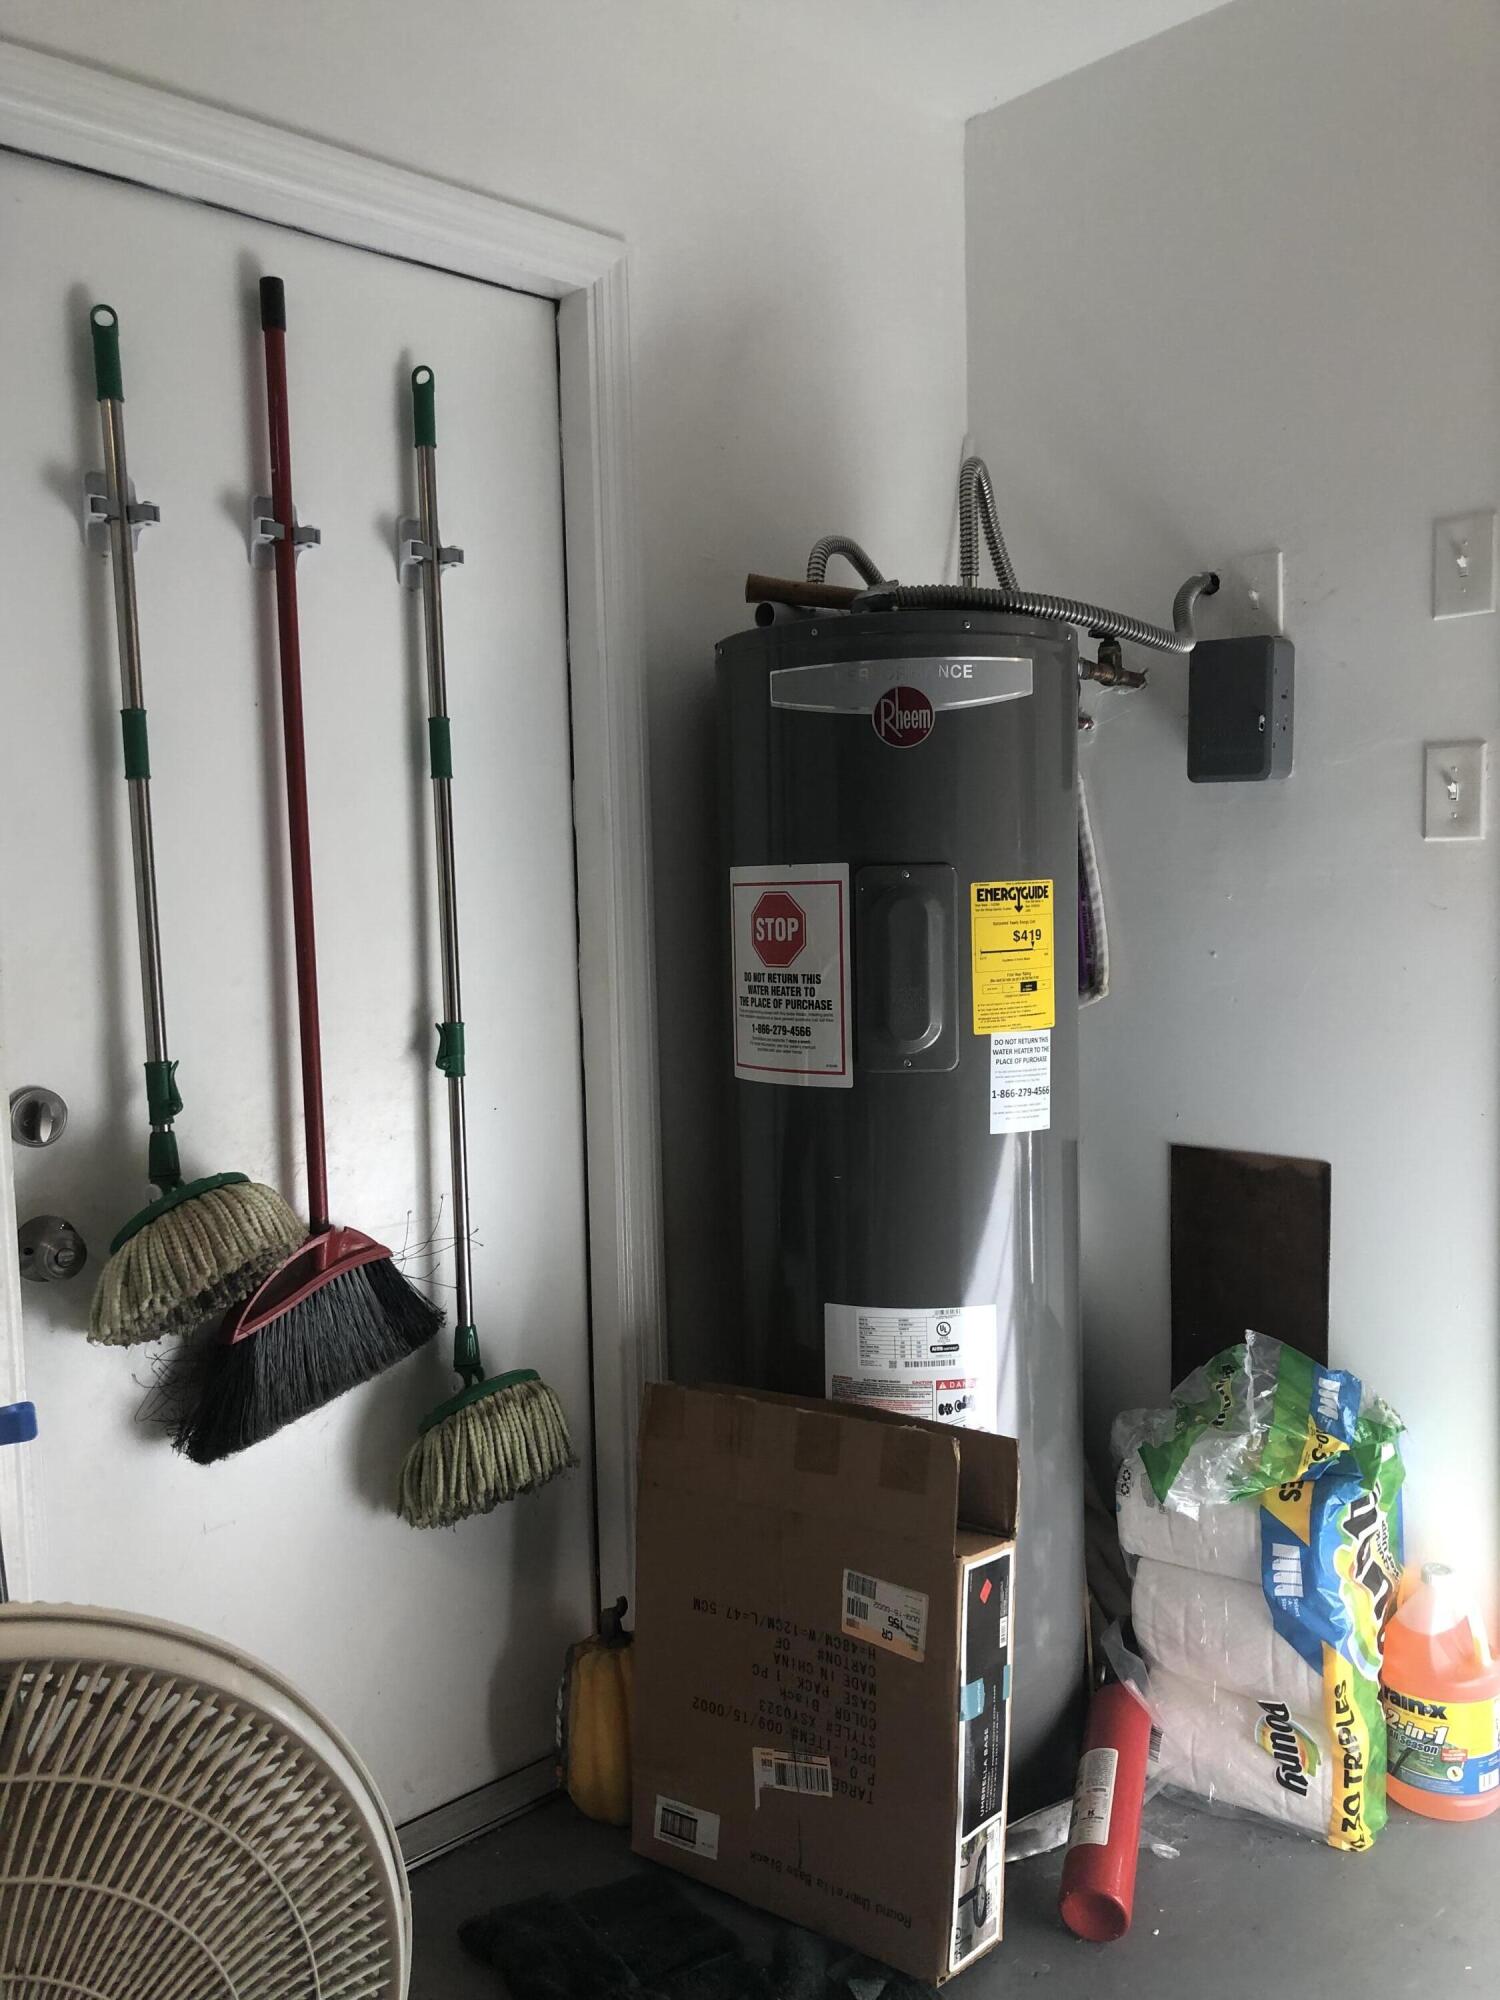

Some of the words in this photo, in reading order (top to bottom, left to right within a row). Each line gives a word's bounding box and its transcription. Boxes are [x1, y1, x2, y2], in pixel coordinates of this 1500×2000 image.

[880, 687, 931, 737] Rheem
[977, 886, 1048, 902] ENERGYGUIDE
[756, 917, 799, 941] STOP
[1013, 929, 1041, 943] $419
[744, 972, 751, 981] DO
[753, 973, 765, 982] NOT
[768, 974, 798, 984] RETURN
[801, 974, 821, 984] THIS
[748, 986, 769, 995] WATER
[771, 986, 801, 996] HEATER
[804, 987, 815, 997] TO
[740, 996, 749, 1006] THE
[751, 997, 771, 1008] PLACE
[773, 998, 783, 1009] OF
[786, 1000, 832, 1010] PURCHASE
[752, 1024, 811, 1036] 1-866-279-4566
[992, 1086, 1049, 1098] 1-866-279-4566
[882, 1629, 893, 1642] CR
[773, 1652, 813, 1677] CHINA
[820, 1667, 834, 1683] IN
[844, 1673, 877, 1696] MADE
[844, 1692, 876, 1713] CASE
[1334, 1679, 1363, 1788] TRIPLES
[1387, 1709, 1449, 1745] 2-in-1
[1400, 1736, 1439, 1755] Season
[832, 1777, 874, 1804] TARGE
[979, 1759, 988, 1816] UMBRELLA
